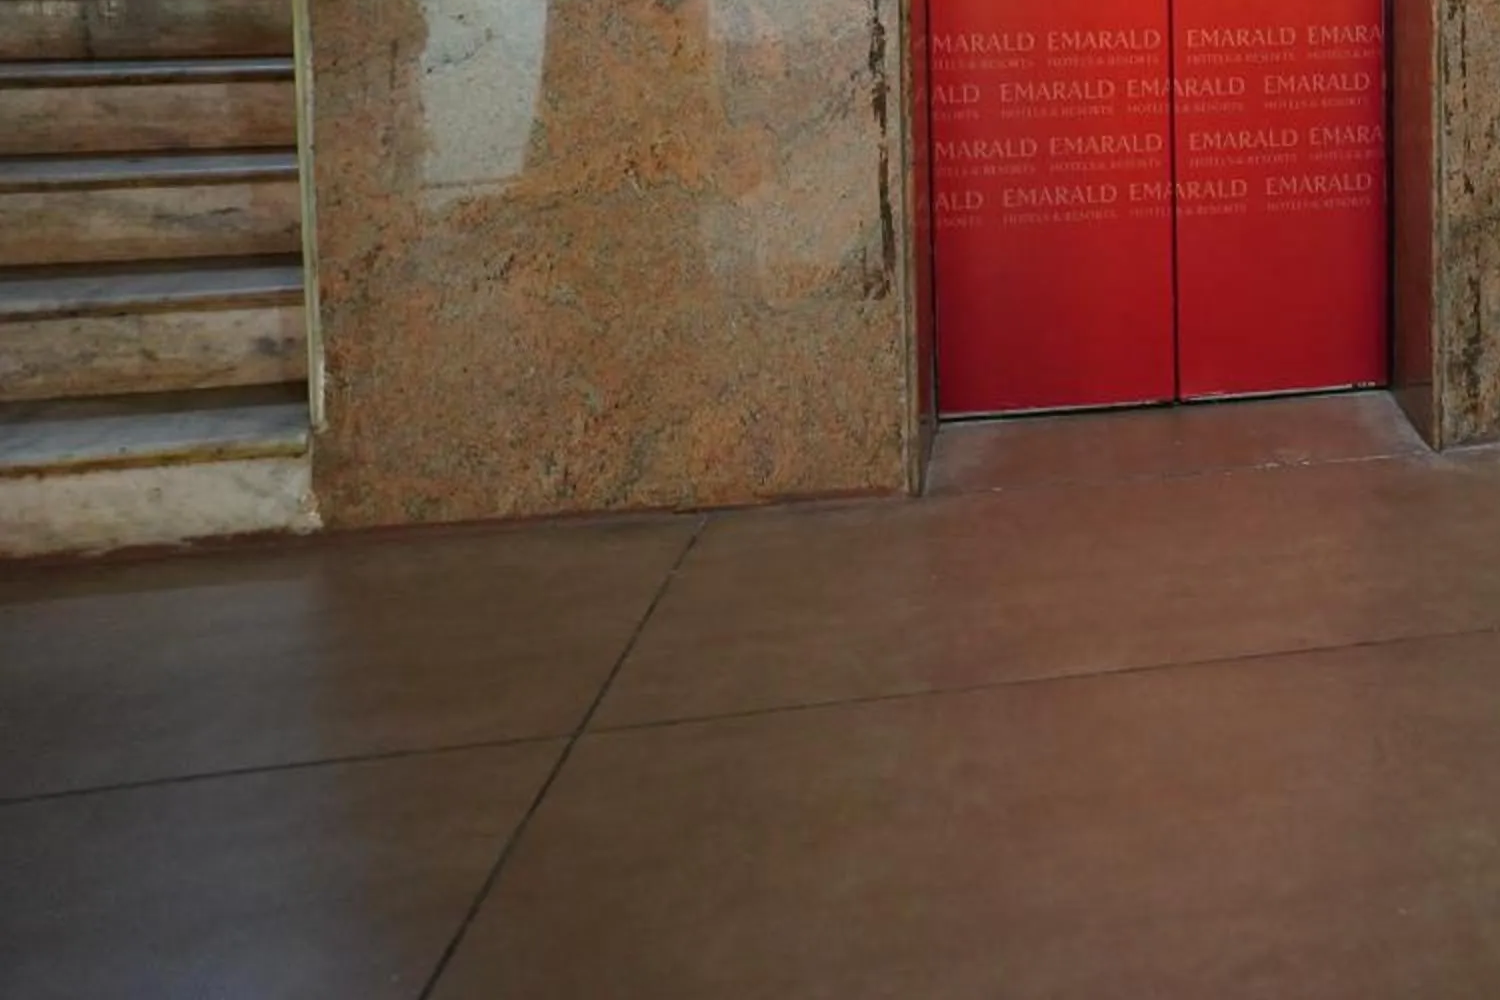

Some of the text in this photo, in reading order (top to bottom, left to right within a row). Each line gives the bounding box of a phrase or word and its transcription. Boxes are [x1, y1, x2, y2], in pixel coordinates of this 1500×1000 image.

[1047, 28, 1161, 51] EMARALD
[1187, 26, 1297, 48] EMARALD
[1000, 78, 1116, 102] EMARALD
[1264, 71, 1371, 94] EMARALD
[1049, 133, 1163, 156] EMARALD
[1189, 128, 1299, 151] EMARALD
[1002, 183, 1118, 208] EMARALD
[1265, 172, 1373, 196] EMARALD
